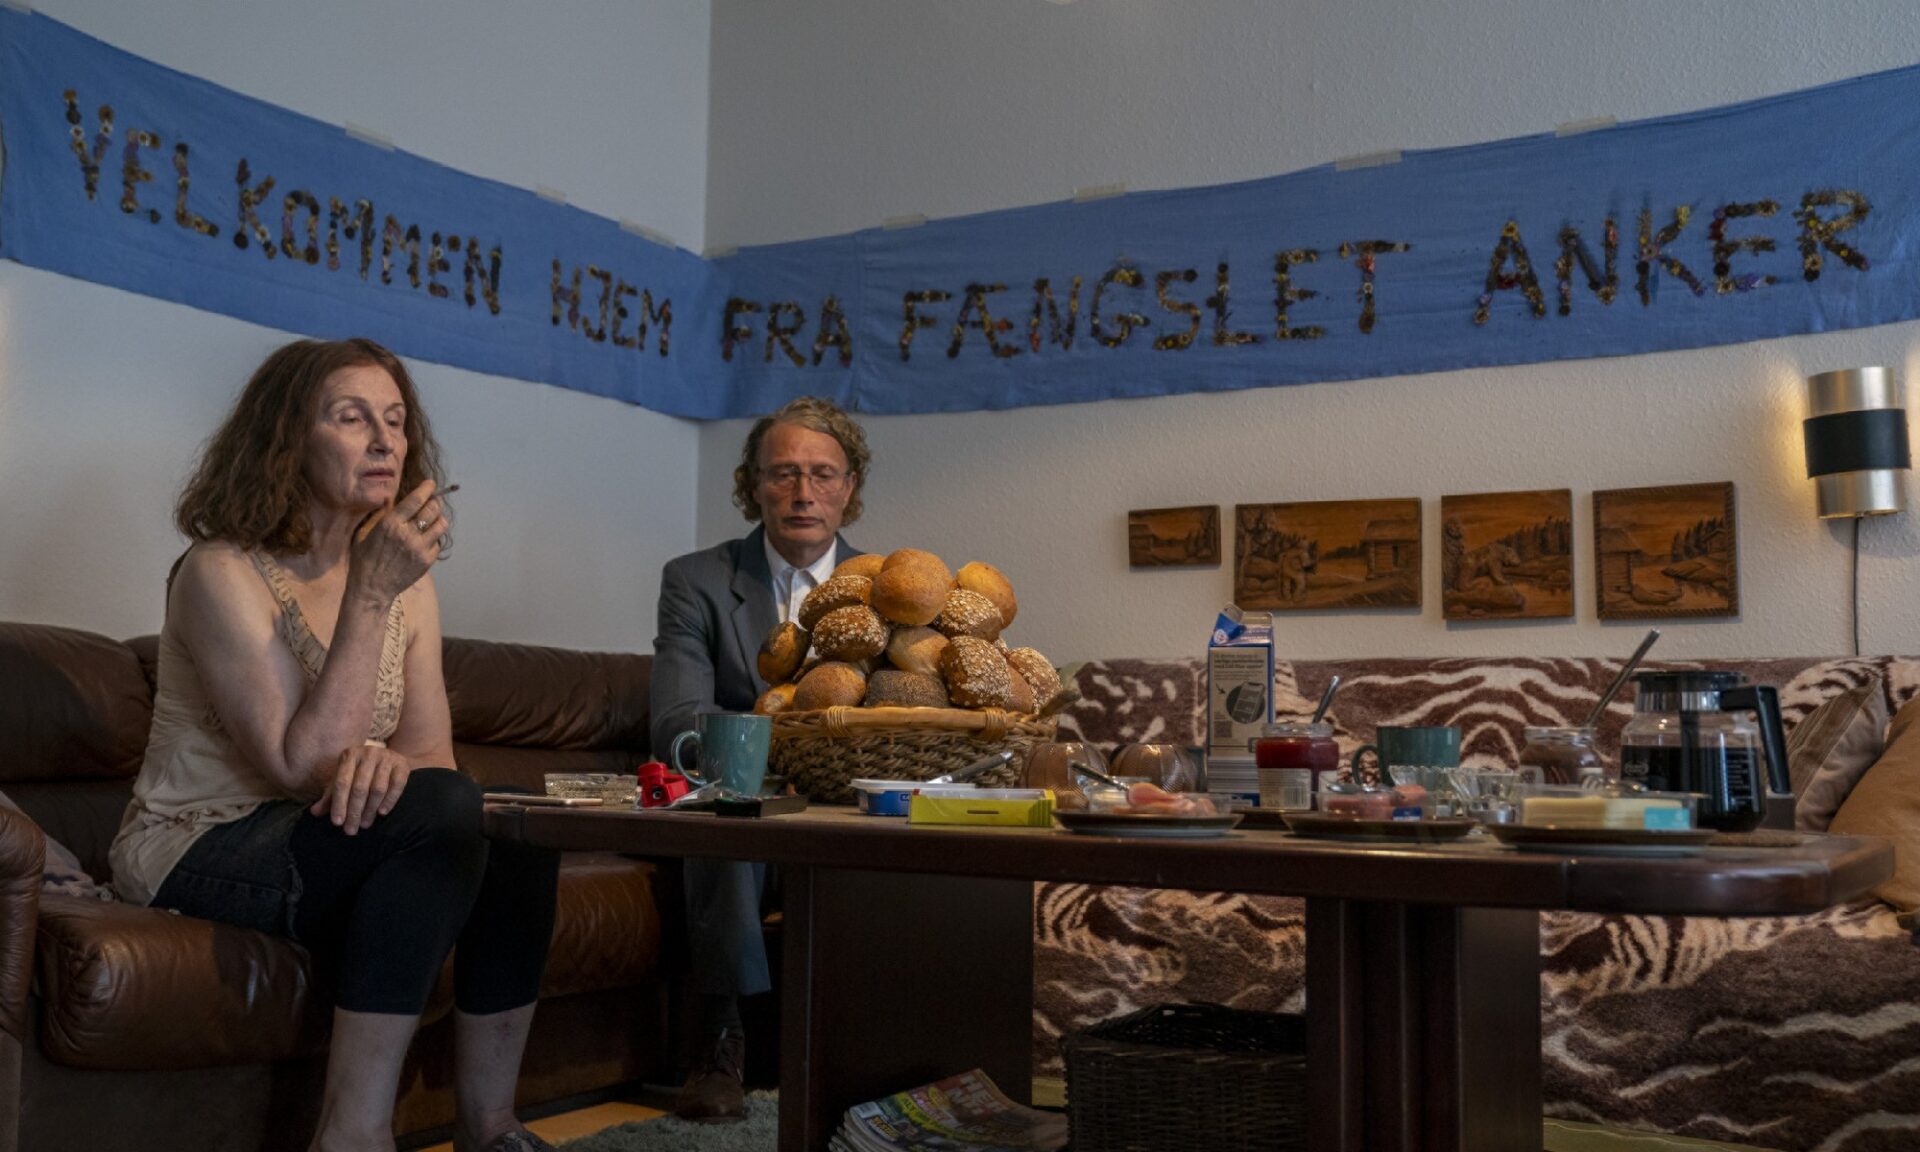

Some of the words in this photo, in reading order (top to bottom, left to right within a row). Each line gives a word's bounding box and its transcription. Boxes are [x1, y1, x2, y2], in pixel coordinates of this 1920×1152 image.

[63, 88, 502, 316] VELKOMMEN
[549, 258, 672, 358] HJEM
[722, 294, 853, 368] FRA
[898, 239, 1411, 362] FÆNGSLET
[1473, 188, 1872, 326] ANKER
